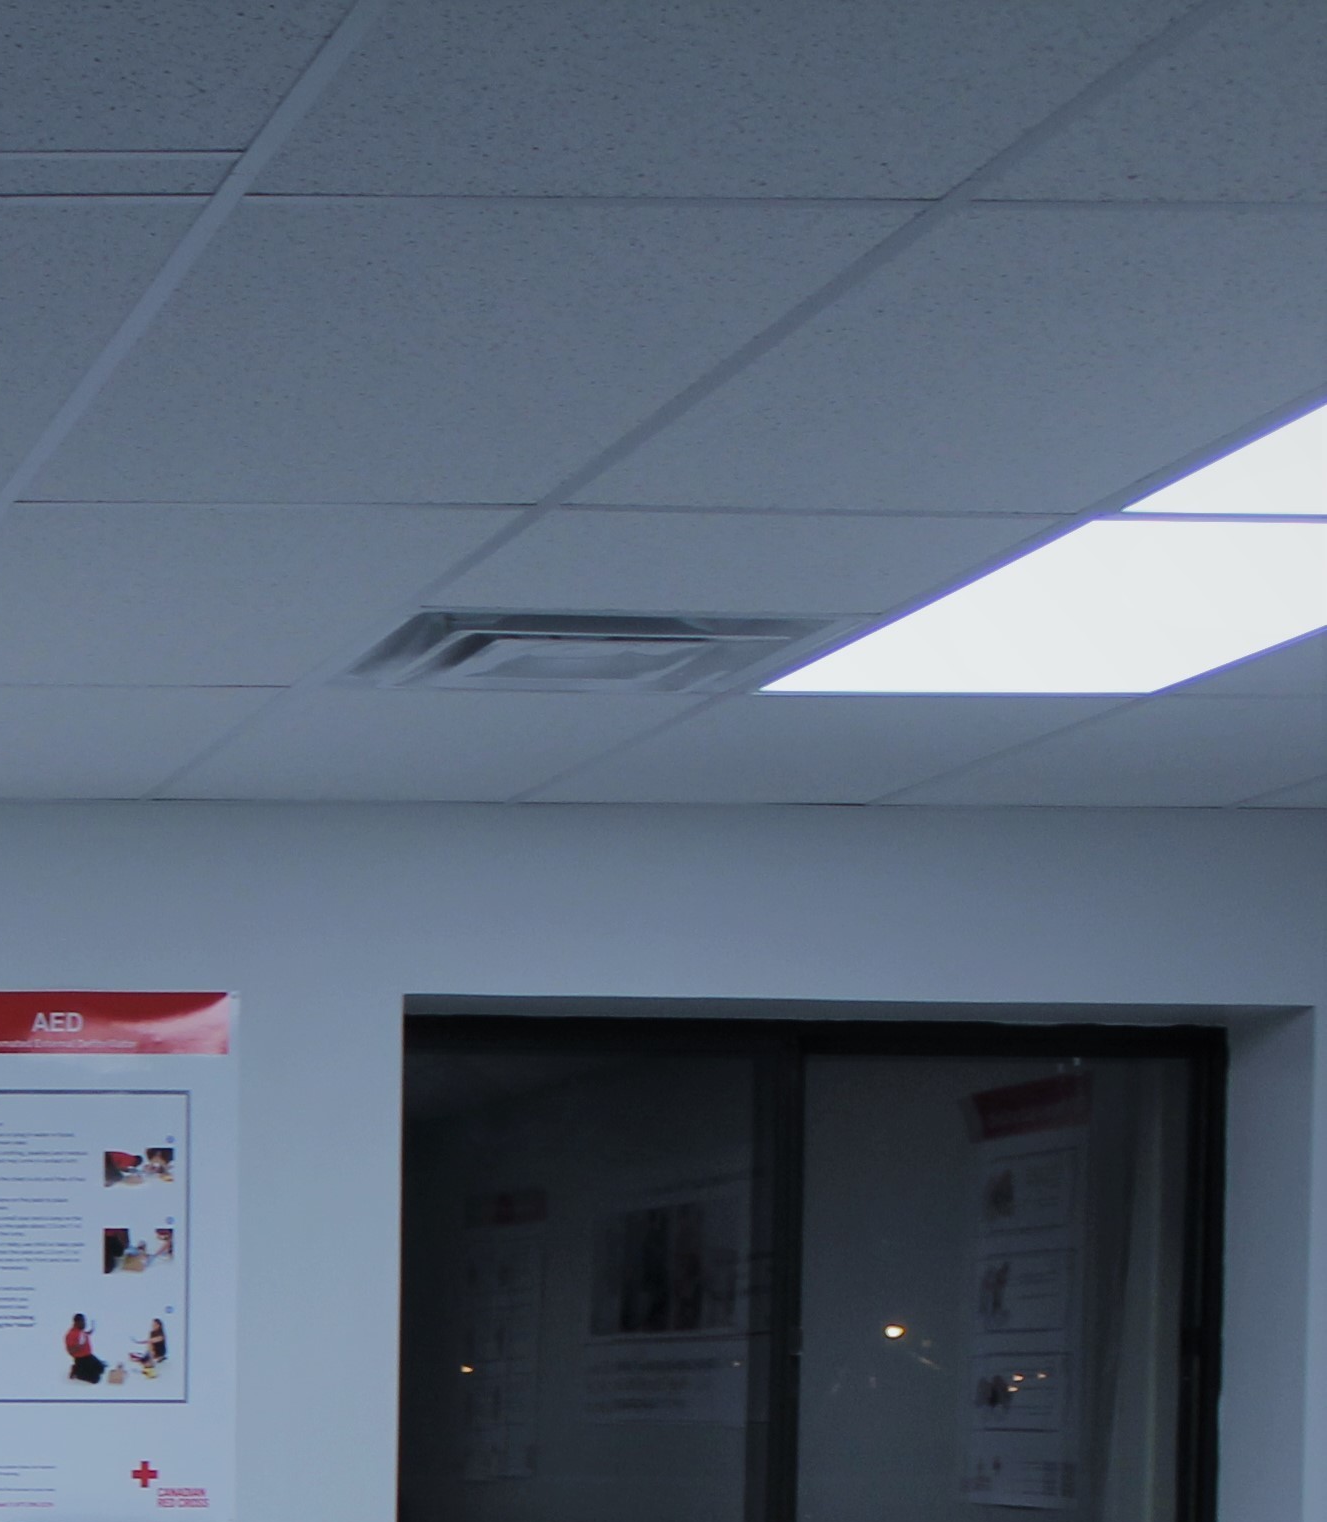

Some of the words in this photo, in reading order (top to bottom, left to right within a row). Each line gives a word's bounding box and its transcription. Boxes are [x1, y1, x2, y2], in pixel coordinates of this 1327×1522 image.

[31, 1012, 84, 1033] AED
[157, 1488, 206, 1497] CANADIAN
[157, 1498, 175, 1507] RED
[178, 1498, 209, 1508] CROSS
